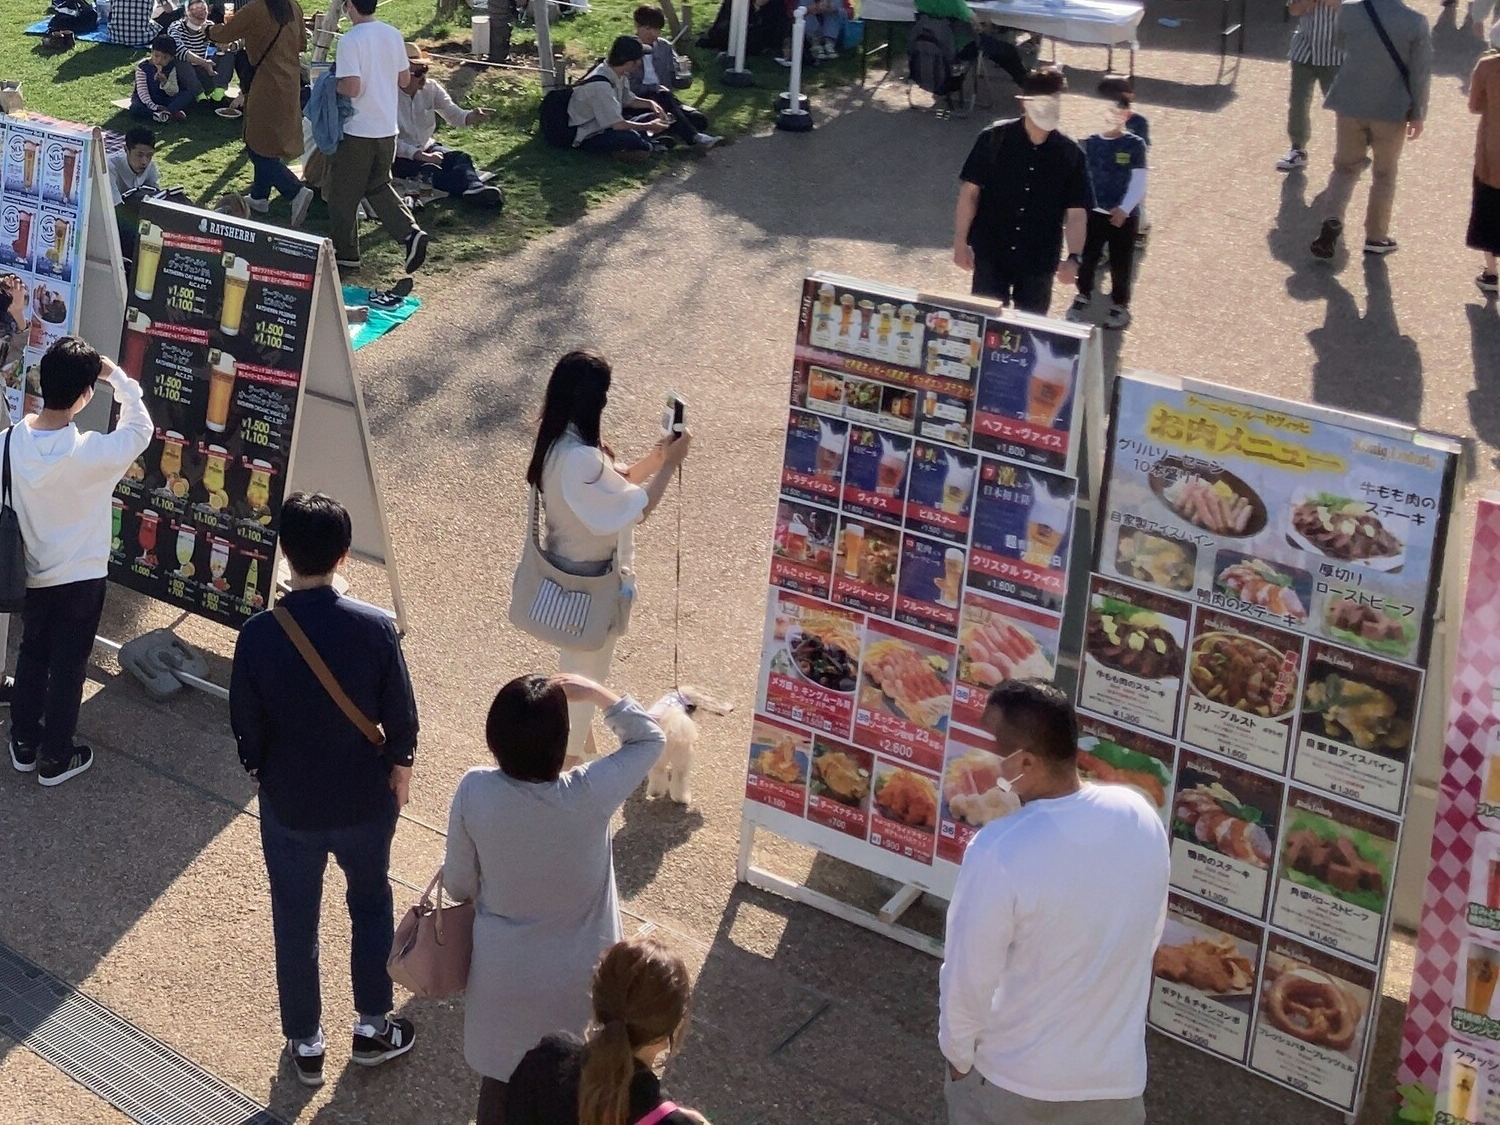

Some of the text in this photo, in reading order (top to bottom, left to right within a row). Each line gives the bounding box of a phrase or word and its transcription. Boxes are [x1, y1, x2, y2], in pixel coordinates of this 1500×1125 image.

[210, 222, 256, 243] RATSHERRN
[1150, 408, 1342, 468] お肉メニュー
[1119, 438, 1225, 474] グリルソーセージ
[786, 473, 836, 493] トラディション
[1360, 481, 1436, 510] 牛もも肉の
[919, 509, 957, 525] ピルスナー
[1365, 502, 1426, 526] ステーキ
[972, 555, 1061, 589] クリスタル ヴァイス
[1319, 563, 1363, 586] 厚切り
[837, 580, 890, 603] ジンジャービア
[1316, 582, 1415, 617] ローストビーフ
[902, 599, 955, 623] フルーツビール
[1196, 588, 1296, 626] 鴨肉のステーキ
